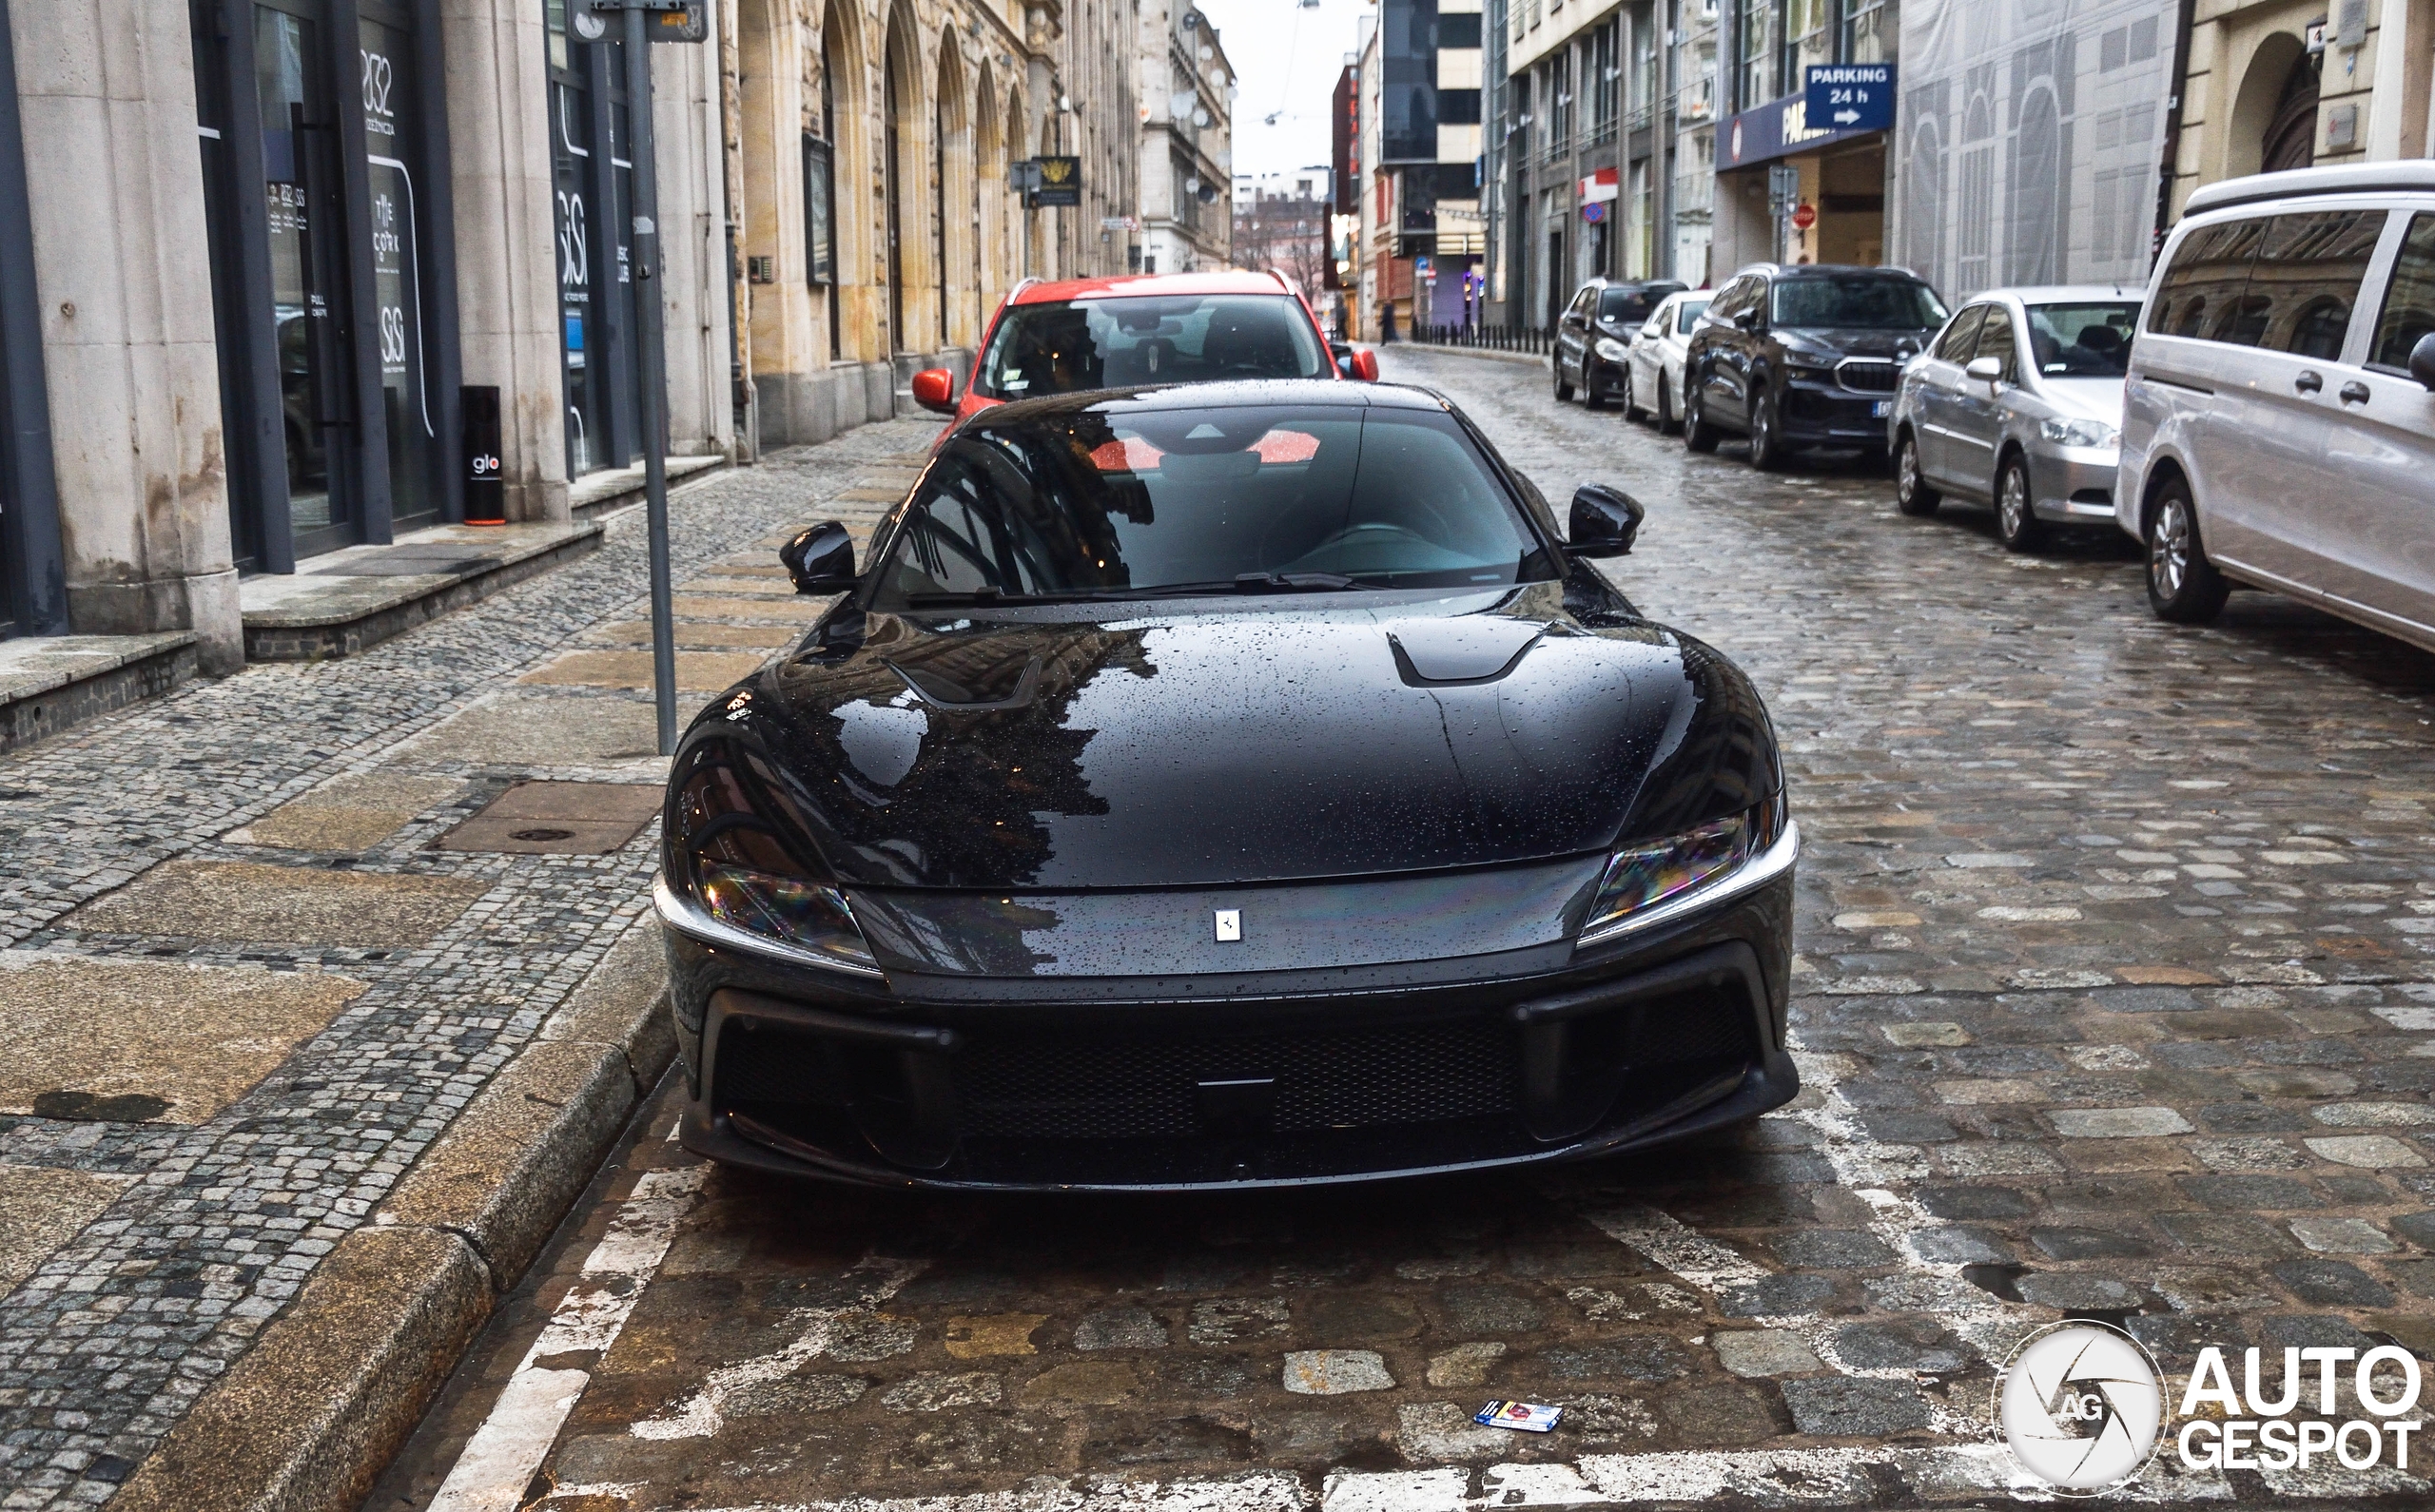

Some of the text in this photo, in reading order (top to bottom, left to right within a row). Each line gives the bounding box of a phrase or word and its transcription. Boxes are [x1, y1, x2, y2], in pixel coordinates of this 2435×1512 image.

[1810, 68, 1887, 84] PARKING
[1829, 88, 1868, 105] 24 h
[473, 453, 499, 475] glo
